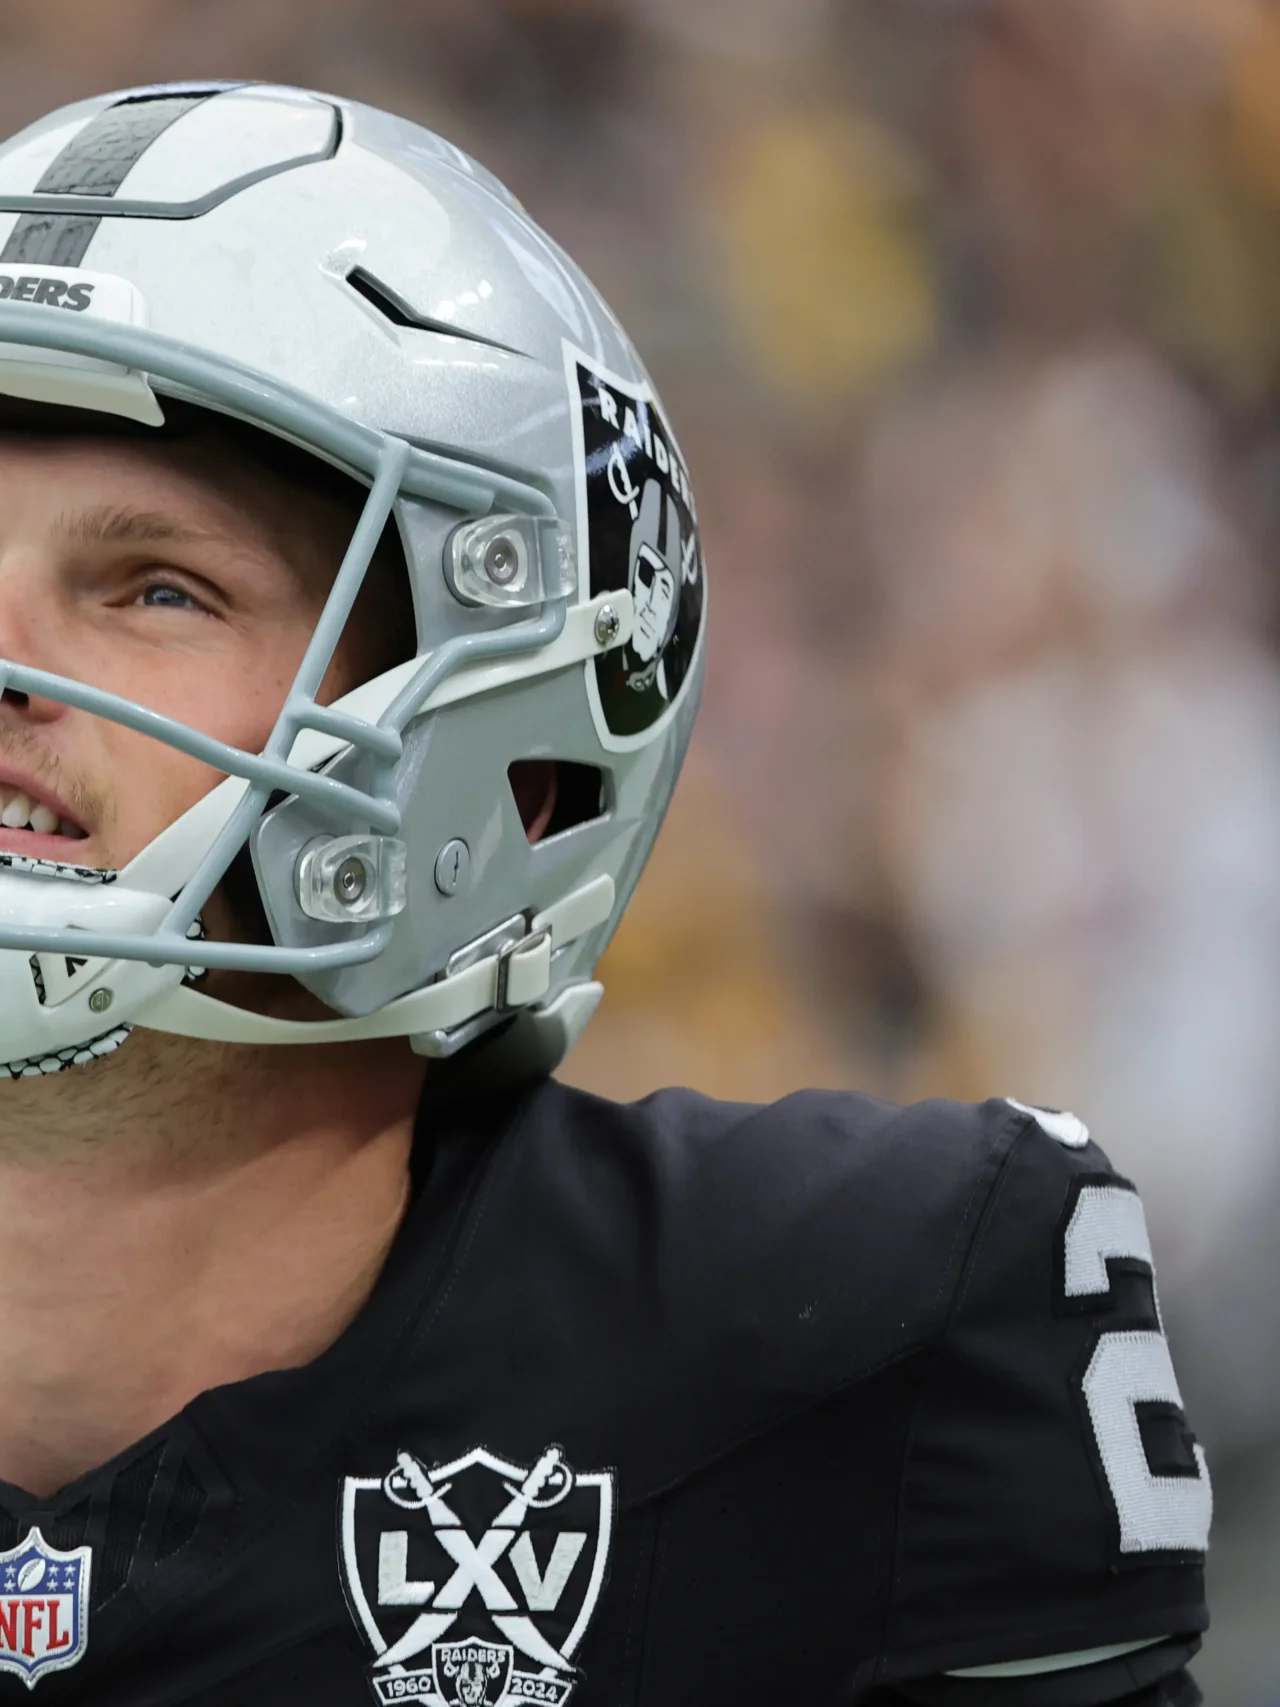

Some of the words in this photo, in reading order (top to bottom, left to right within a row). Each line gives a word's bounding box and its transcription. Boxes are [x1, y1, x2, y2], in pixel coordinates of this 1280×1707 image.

[377, 1529, 587, 1611] LXV
[440, 1648, 507, 1664] RAIDERS
[386, 1676, 432, 1698] 1960
[510, 1678, 559, 1703] 2024
